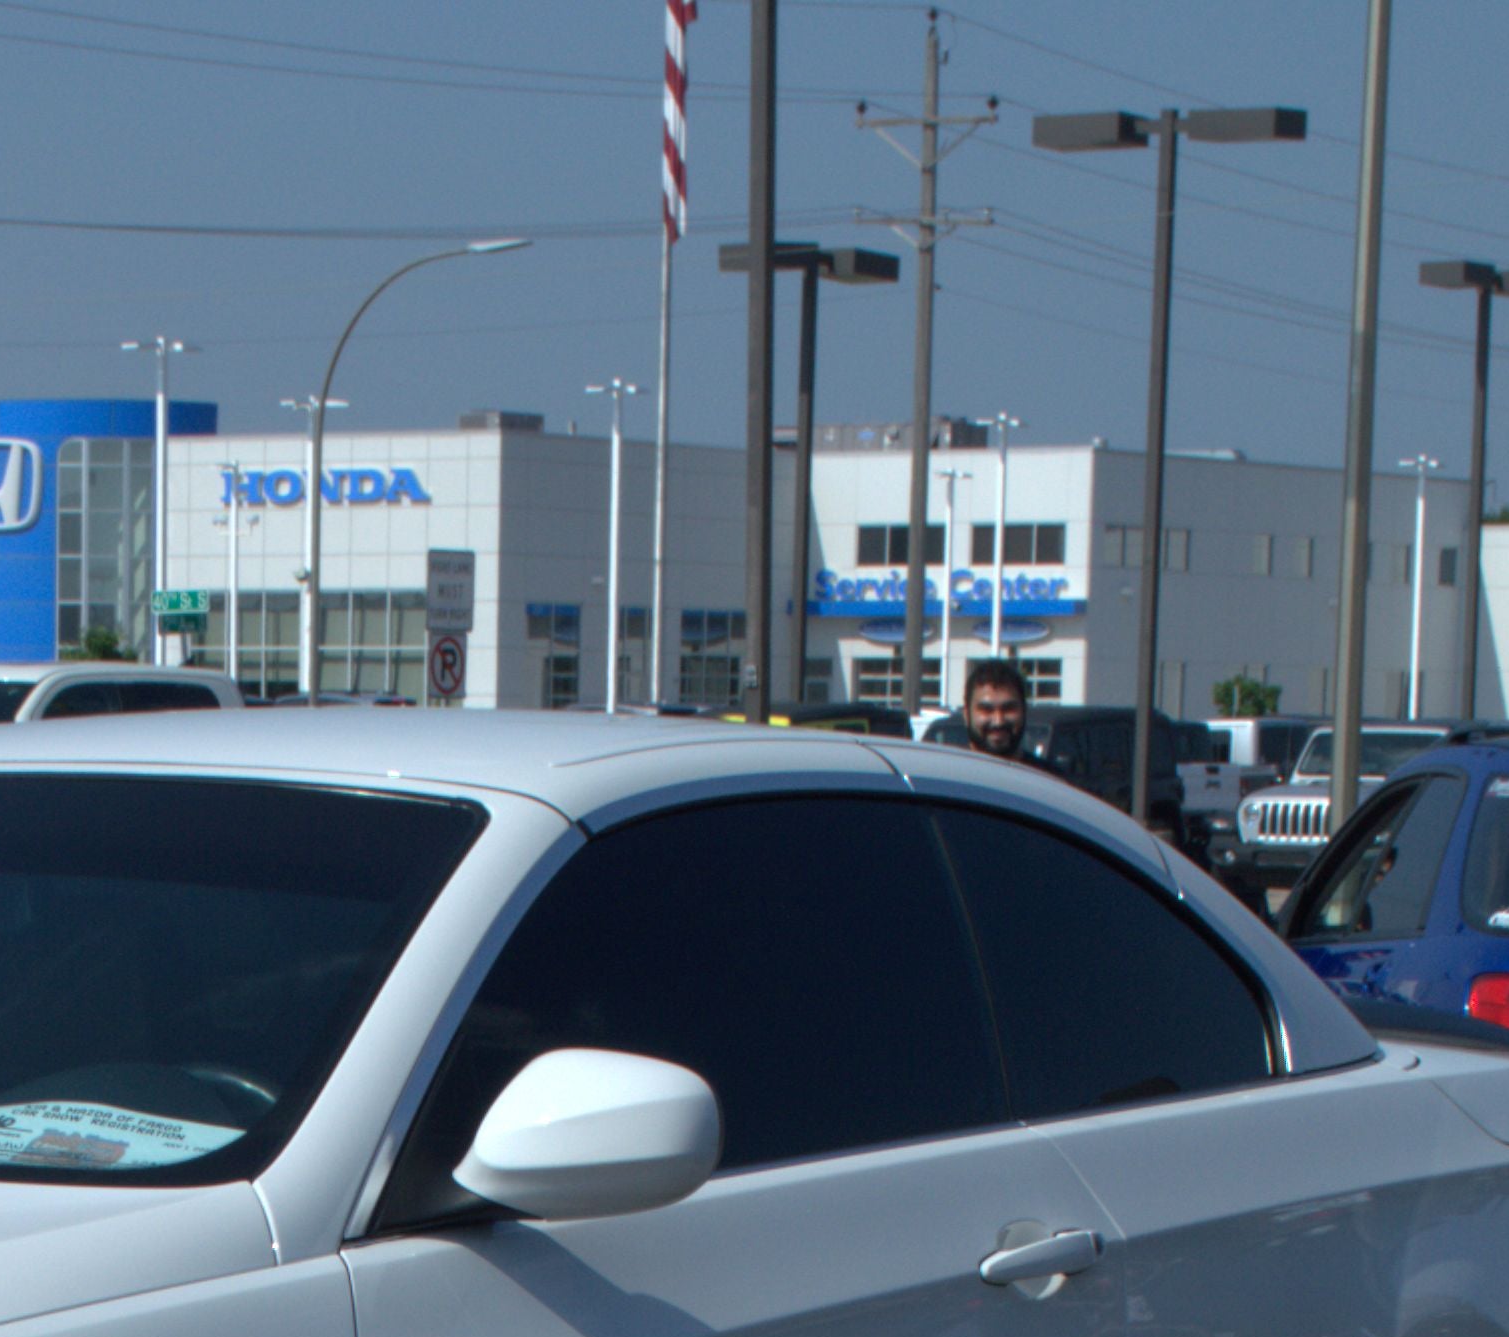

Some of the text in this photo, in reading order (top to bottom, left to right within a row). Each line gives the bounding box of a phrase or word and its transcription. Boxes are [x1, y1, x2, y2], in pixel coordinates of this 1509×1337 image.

[221, 468, 431, 505] HONDA
[11, 1109, 186, 1141] CAR SHOW REGISTRATION
[65, 1107, 113, 1118] MAZDA
[138, 1119, 184, 1132] FARGO
